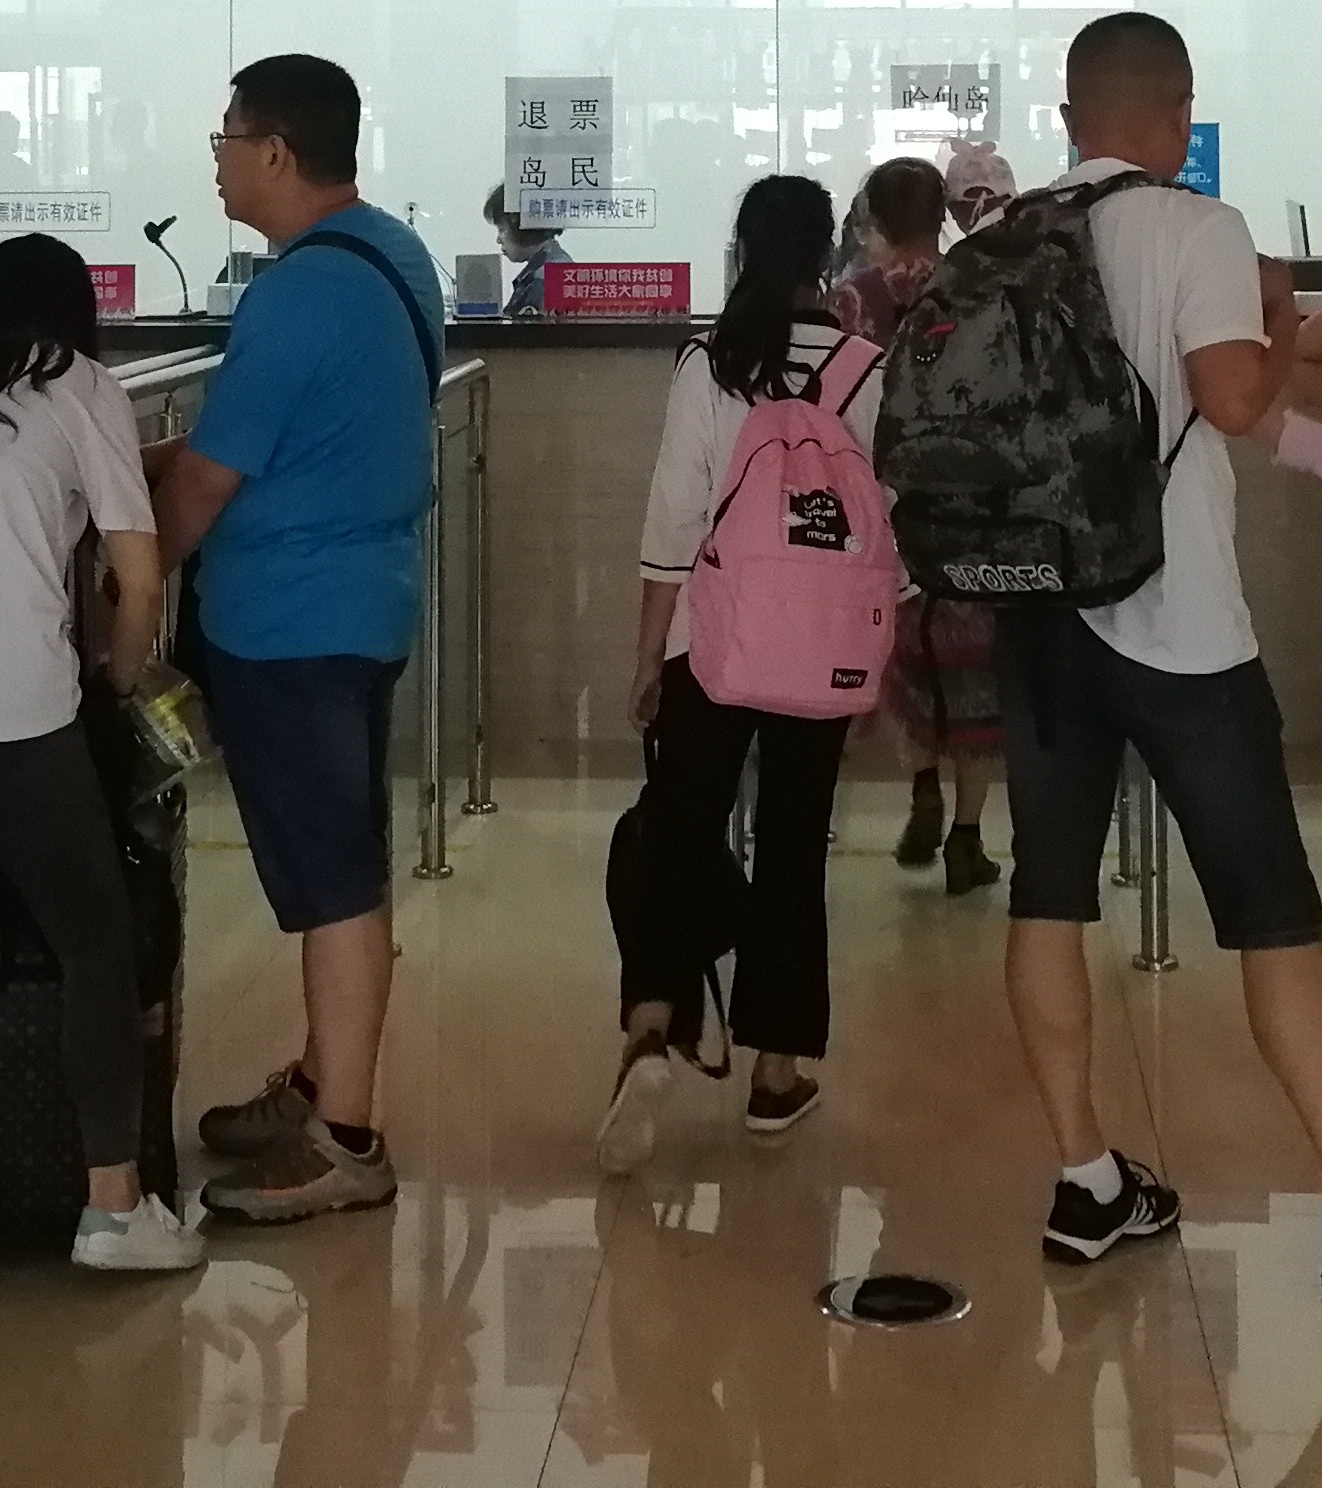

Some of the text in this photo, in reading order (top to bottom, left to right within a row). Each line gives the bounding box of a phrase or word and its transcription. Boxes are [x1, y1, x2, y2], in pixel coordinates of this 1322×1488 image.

[517, 98, 600, 131] 退票
[519, 156, 599, 189] 岛民
[528, 198, 648, 219] 购票请出示有效证件
[943, 563, 1064, 592] SPORTS
[835, 672, 863, 685] hurry
